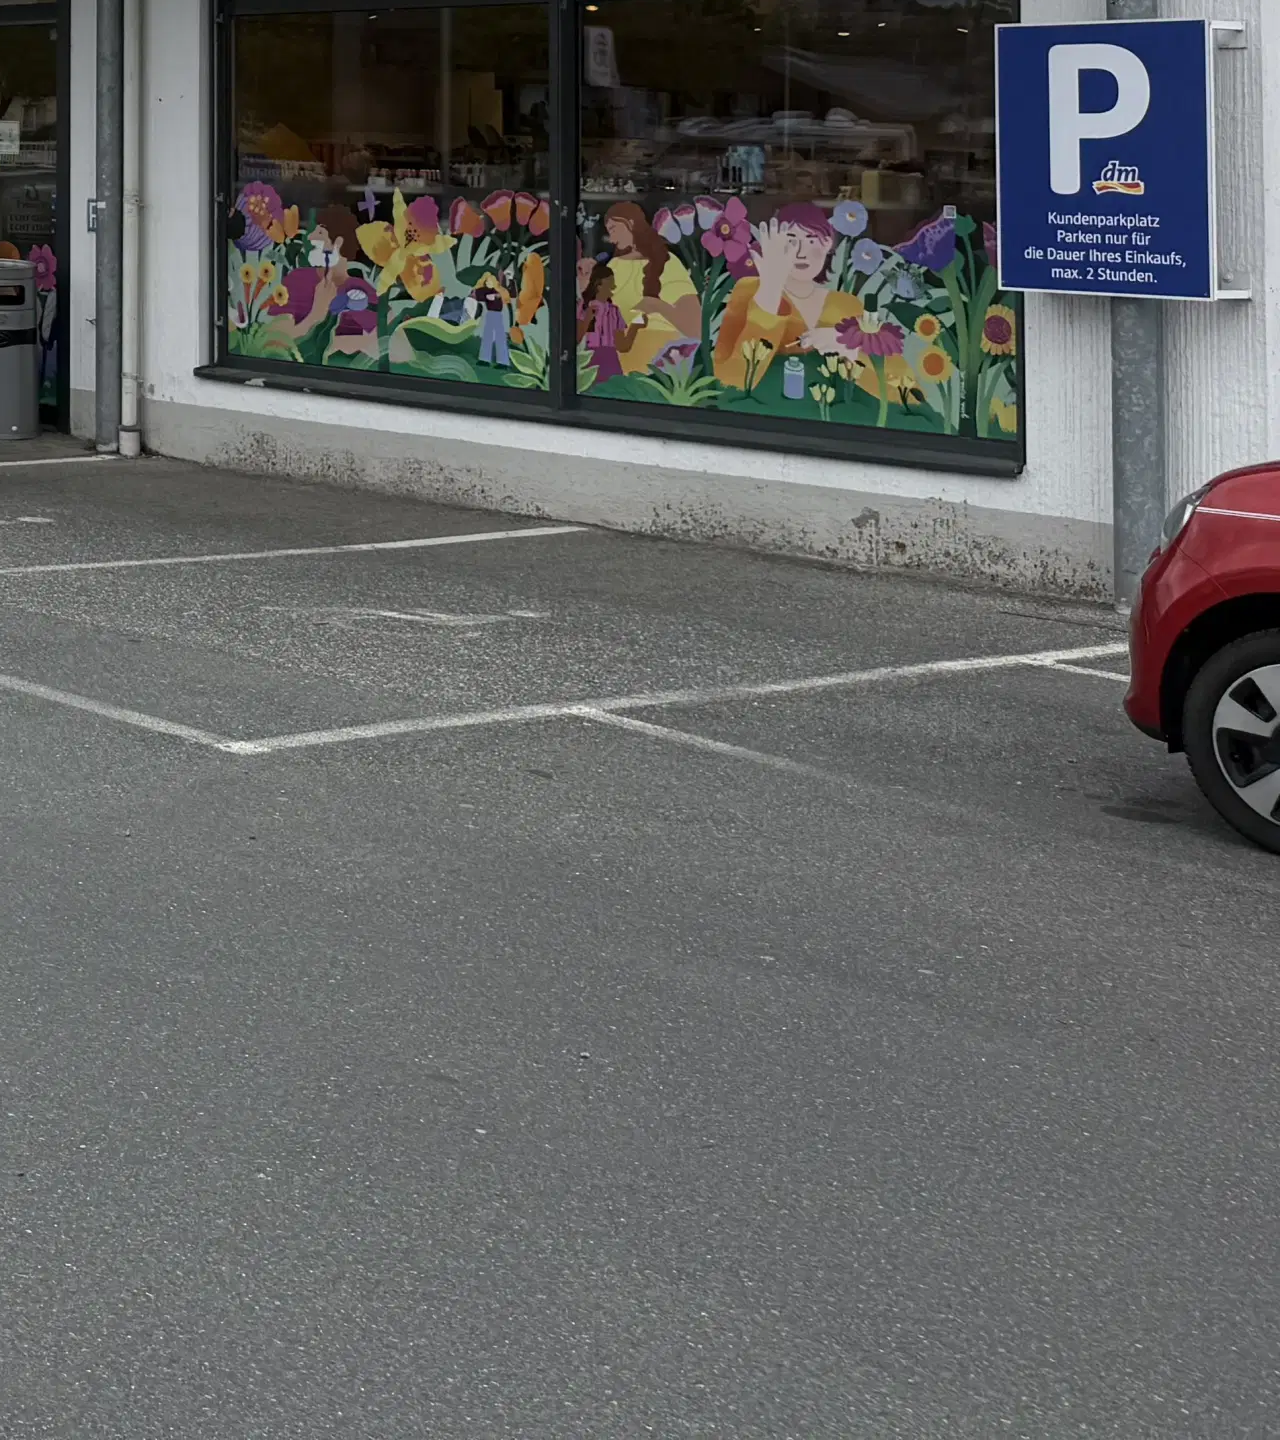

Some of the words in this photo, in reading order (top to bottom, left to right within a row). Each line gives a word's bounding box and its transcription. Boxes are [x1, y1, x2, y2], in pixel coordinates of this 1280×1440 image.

[1048, 43, 1151, 195] P
[1101, 161, 1140, 183] dm
[1047, 212, 1160, 229] Kundenparkplatz
[1056, 230, 1102, 244] Parken
[1105, 234, 1128, 245] nur
[1131, 231, 1151, 246] für
[1024, 246, 1044, 260] die
[1047, 248, 1085, 262] Dauer
[1089, 249, 1122, 263] Ihres
[1125, 250, 1187, 267] Einkaufs,
[1051, 268, 1083, 280] max.
[1086, 267, 1094, 280] 2
[1097, 268, 1158, 283] Stunden.
